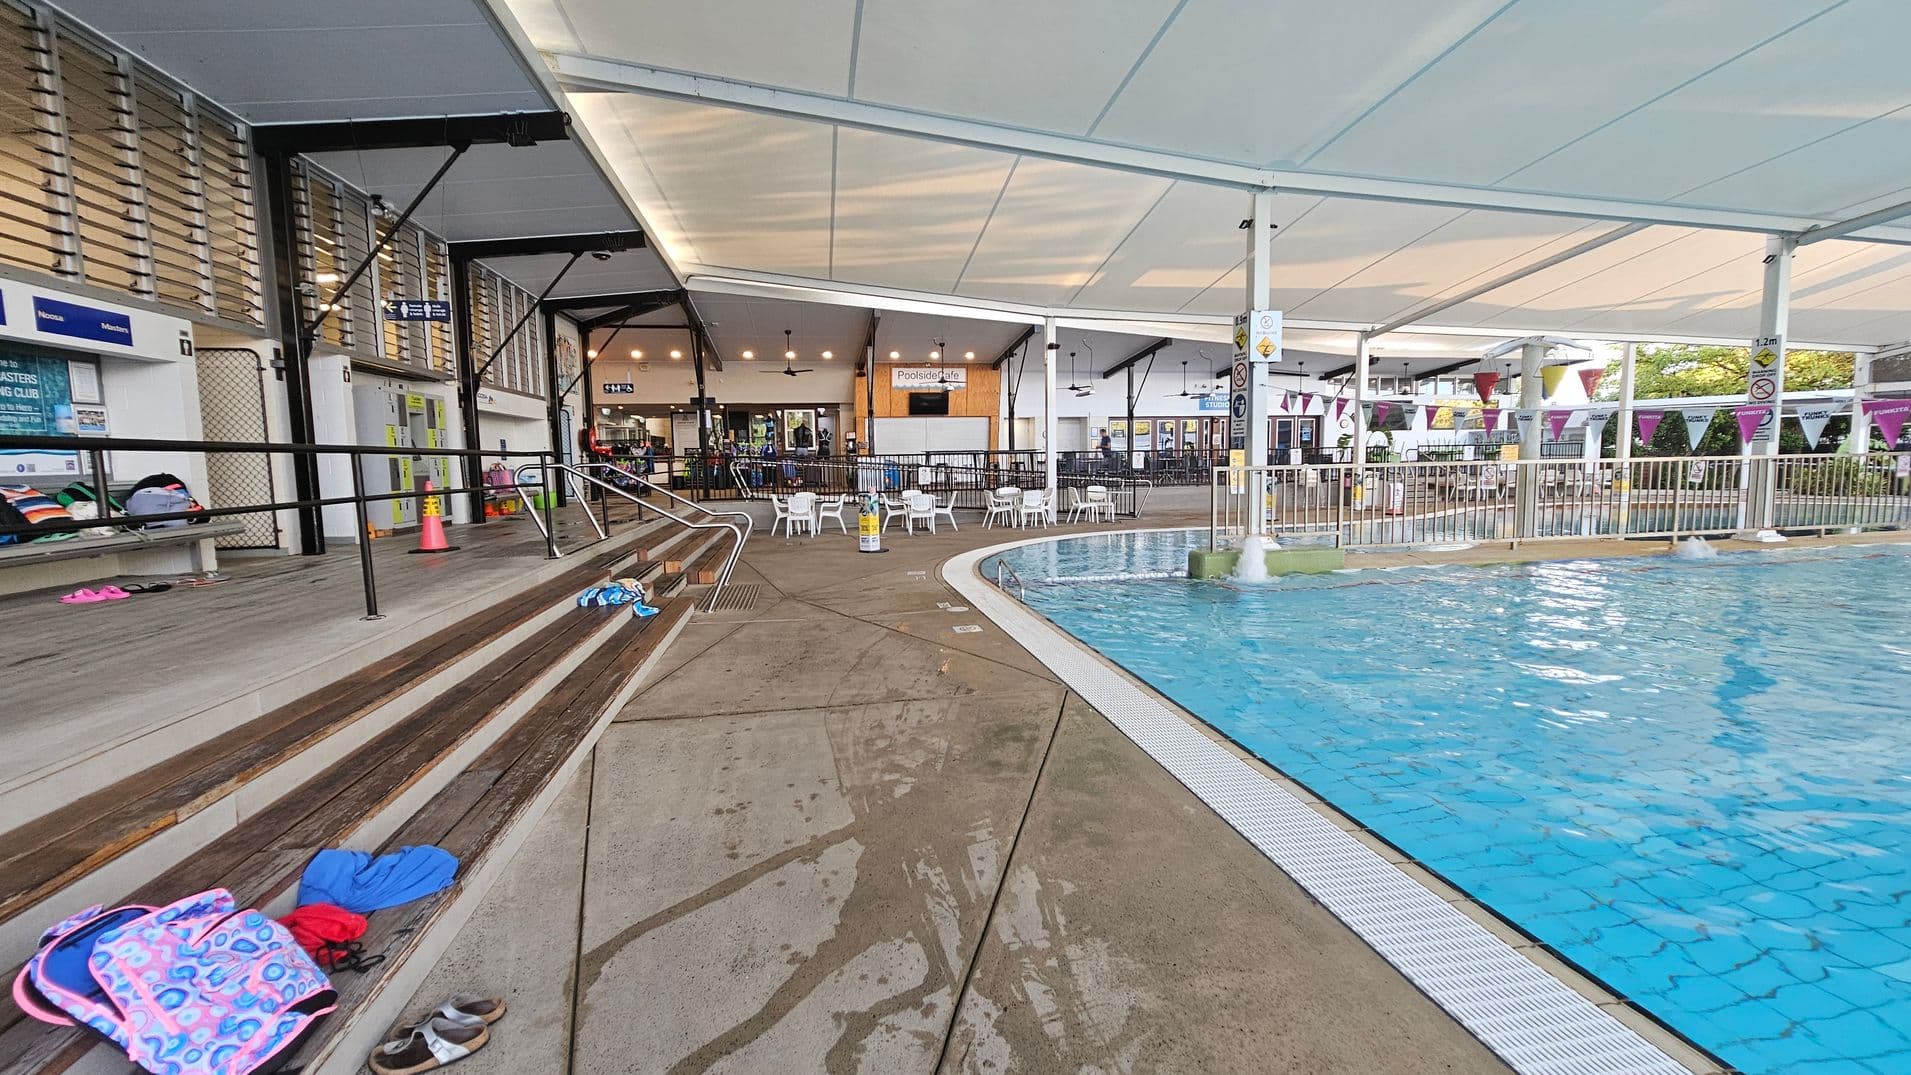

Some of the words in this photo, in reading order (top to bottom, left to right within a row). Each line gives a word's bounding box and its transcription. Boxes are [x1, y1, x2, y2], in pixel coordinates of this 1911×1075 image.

[37, 310, 64, 322] Noosa
[101, 322, 129, 334] Masters
[1755, 337, 1777, 347] 1.2m
[0, 371, 38, 384] ASTERS
[14, 387, 39, 399] CLUB
[1873, 407, 1909, 415] FUNKITA
